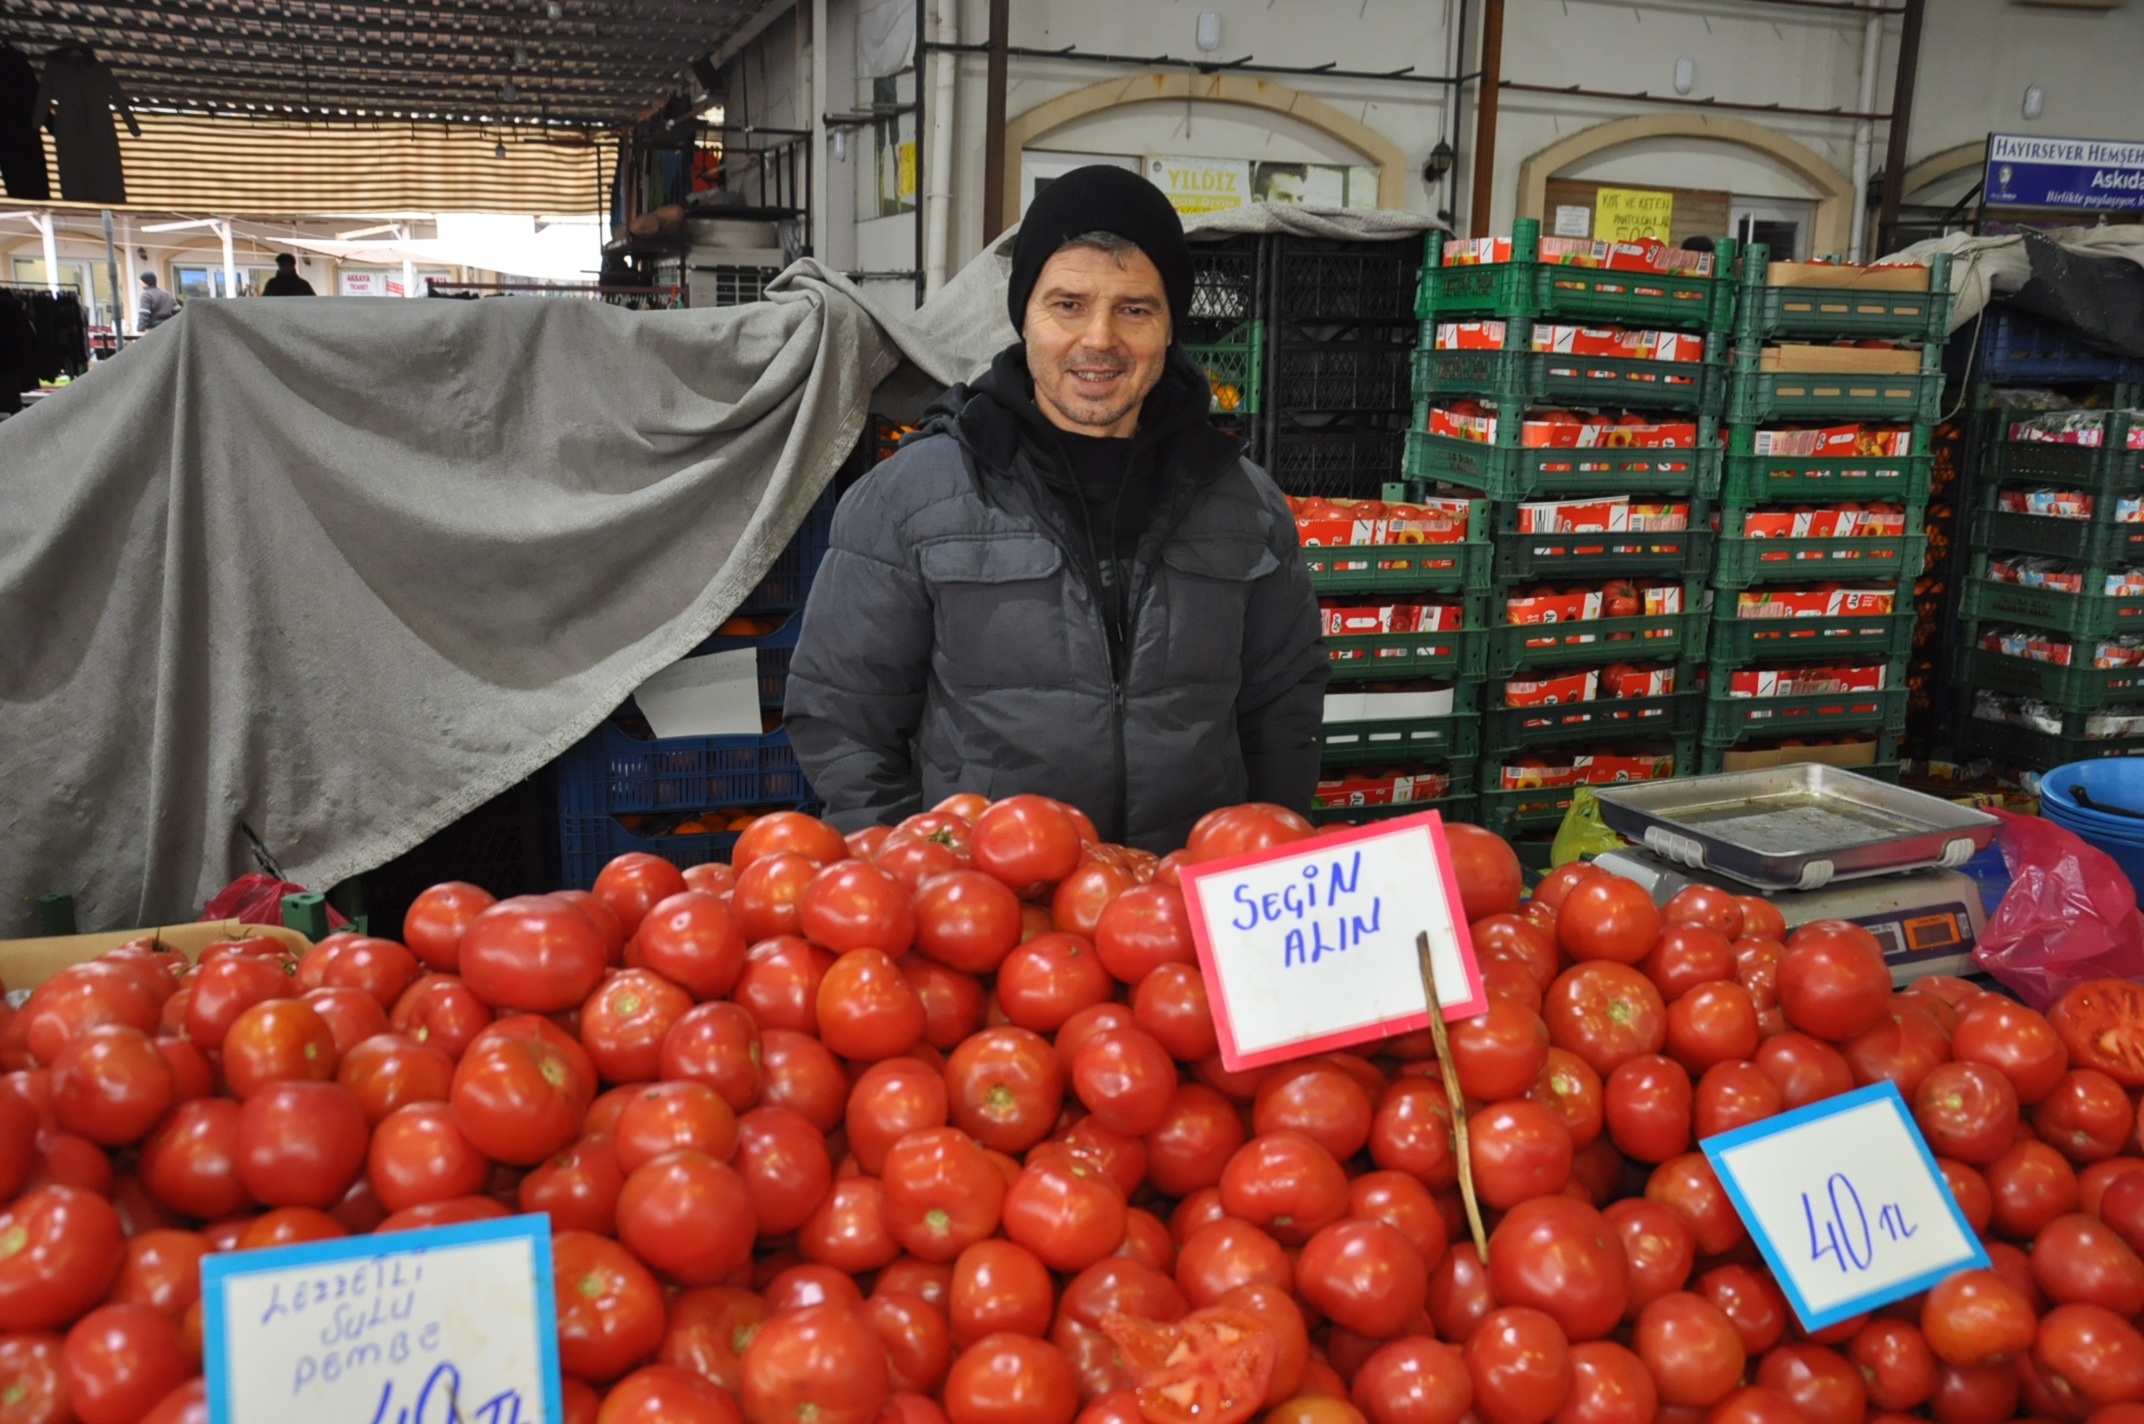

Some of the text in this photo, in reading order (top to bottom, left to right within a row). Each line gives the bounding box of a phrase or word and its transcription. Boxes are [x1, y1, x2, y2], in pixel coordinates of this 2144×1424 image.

[1996, 139, 2083, 161] HAYIRSEVER
[1167, 169, 1237, 192] YILDIZ
[1638, 196, 1670, 210] KETEN
[1284, 897, 1381, 968] ALIN
[1801, 1173, 1918, 1273] 40 TL
